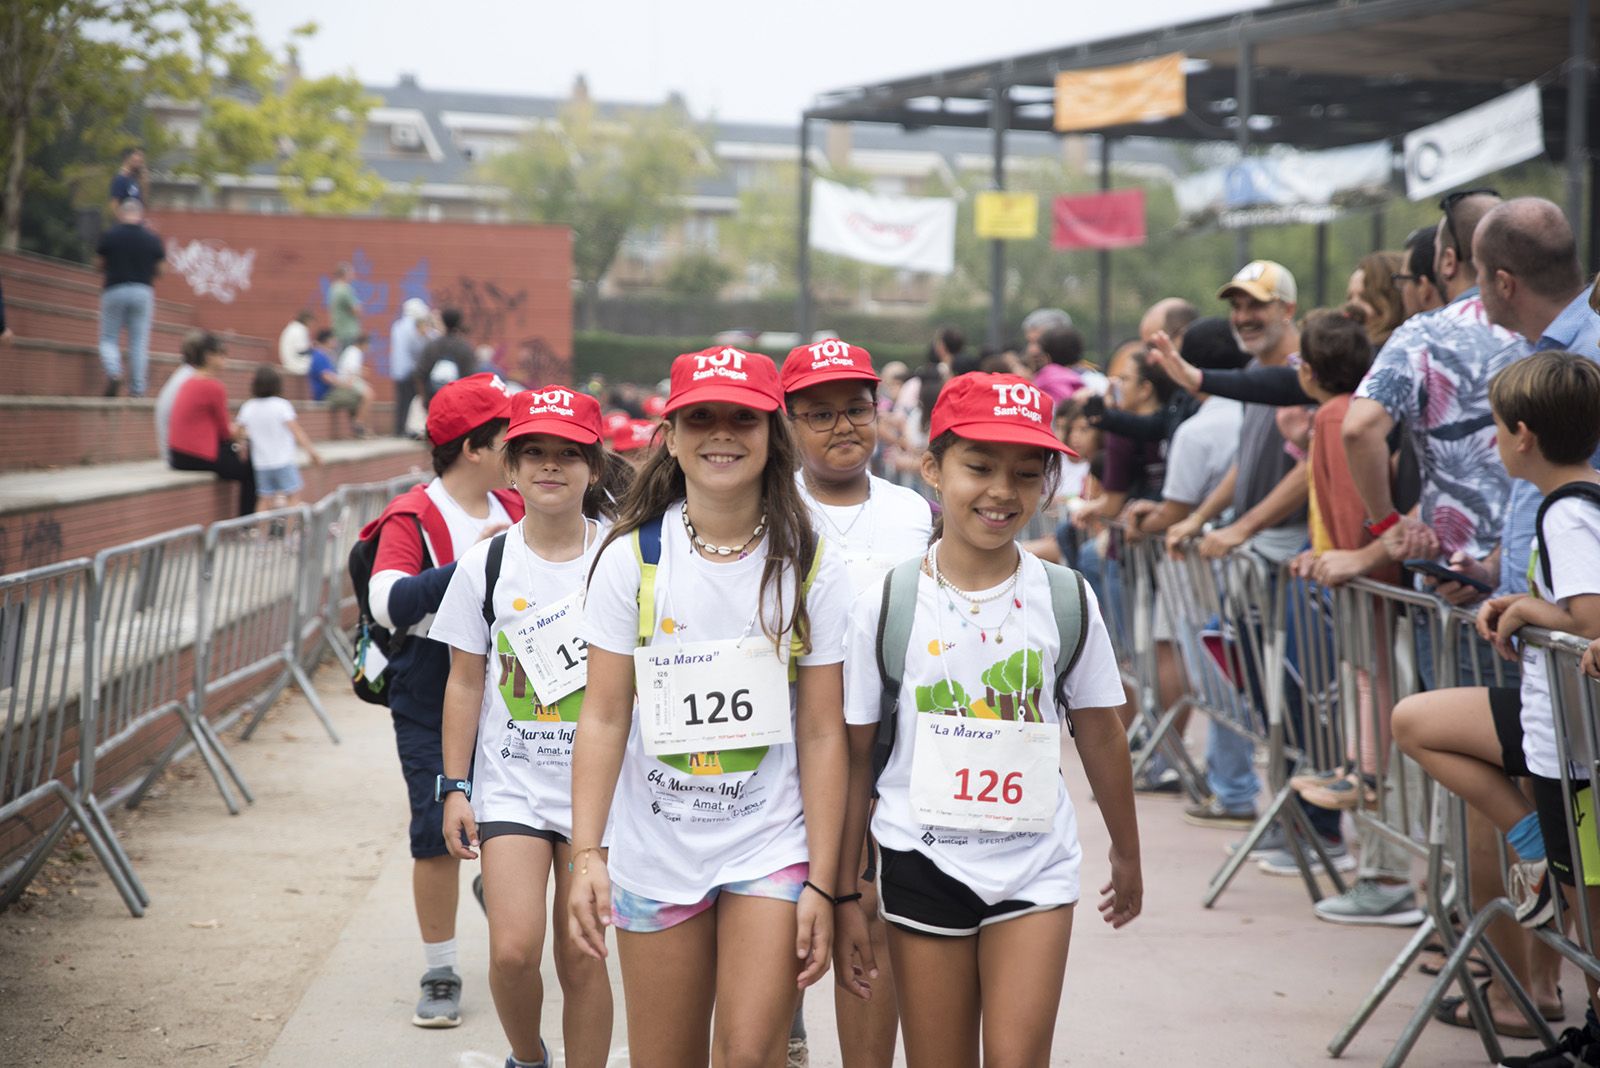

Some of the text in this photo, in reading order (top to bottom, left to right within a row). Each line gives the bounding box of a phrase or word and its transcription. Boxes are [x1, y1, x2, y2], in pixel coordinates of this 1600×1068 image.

[693, 348, 746, 369] TOT
[808, 340, 850, 361] TOT
[531, 389, 574, 407] TOT
[992, 383, 1041, 410] TOT
[993, 406, 1018, 416] Sant
[683, 688, 753, 726] 126
[668, 777, 716, 794] Marxa
[953, 767, 1023, 805] 126
